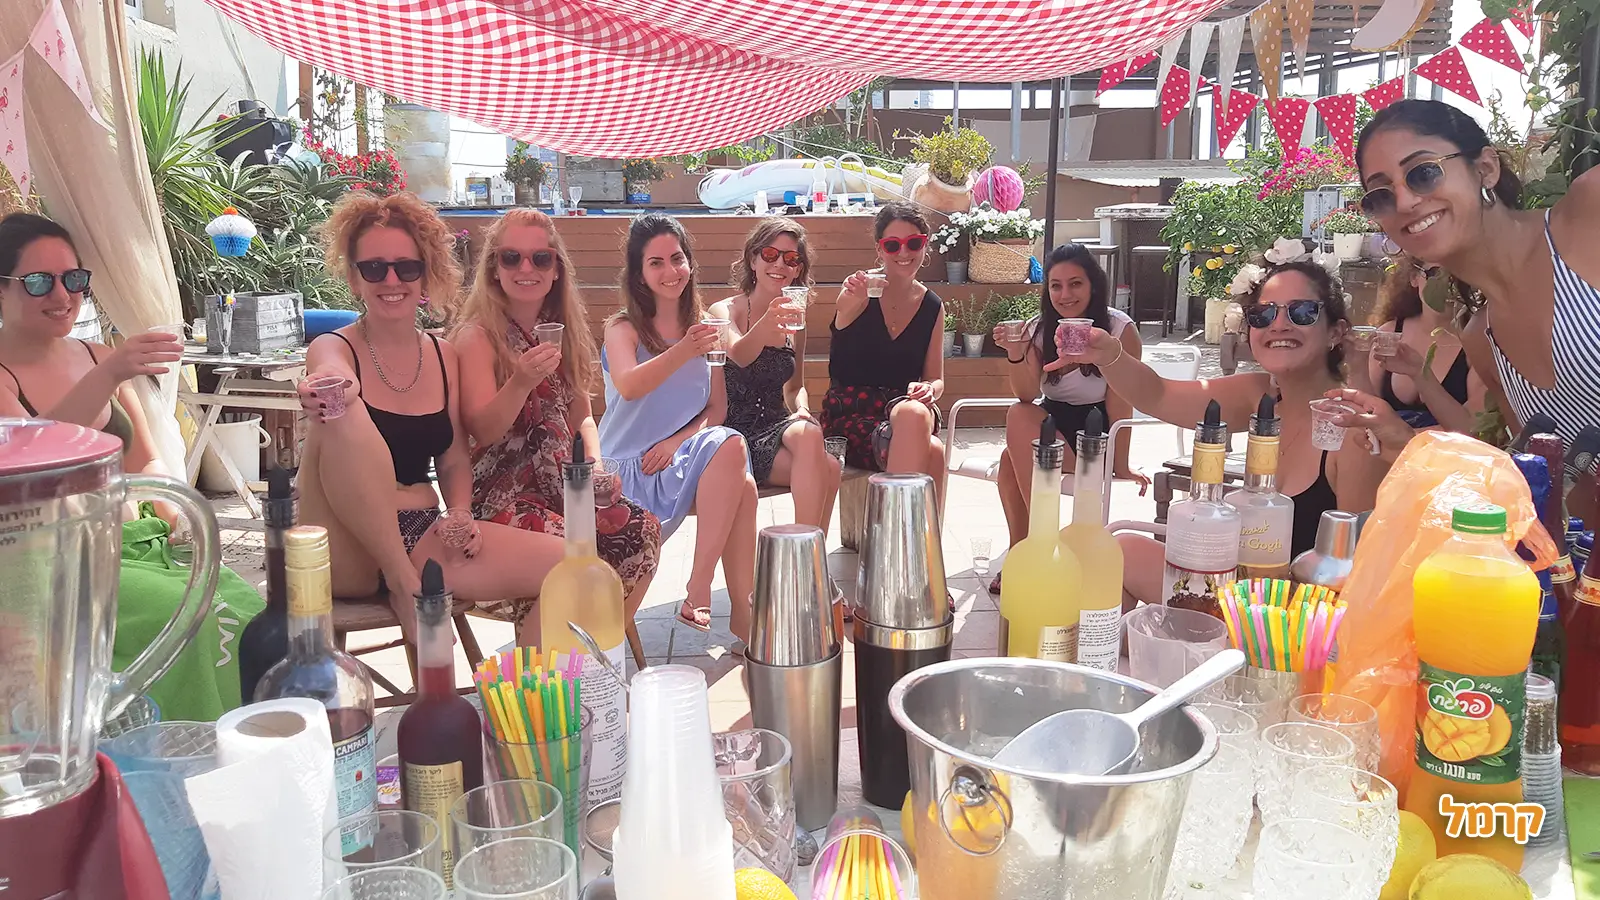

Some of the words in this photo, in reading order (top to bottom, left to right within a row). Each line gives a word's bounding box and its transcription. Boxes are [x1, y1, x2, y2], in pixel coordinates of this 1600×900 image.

[1248, 537, 1283, 554] Gogh
[336, 735, 368, 757] CAMPARI
[1442, 762, 1466, 779] מנגו
